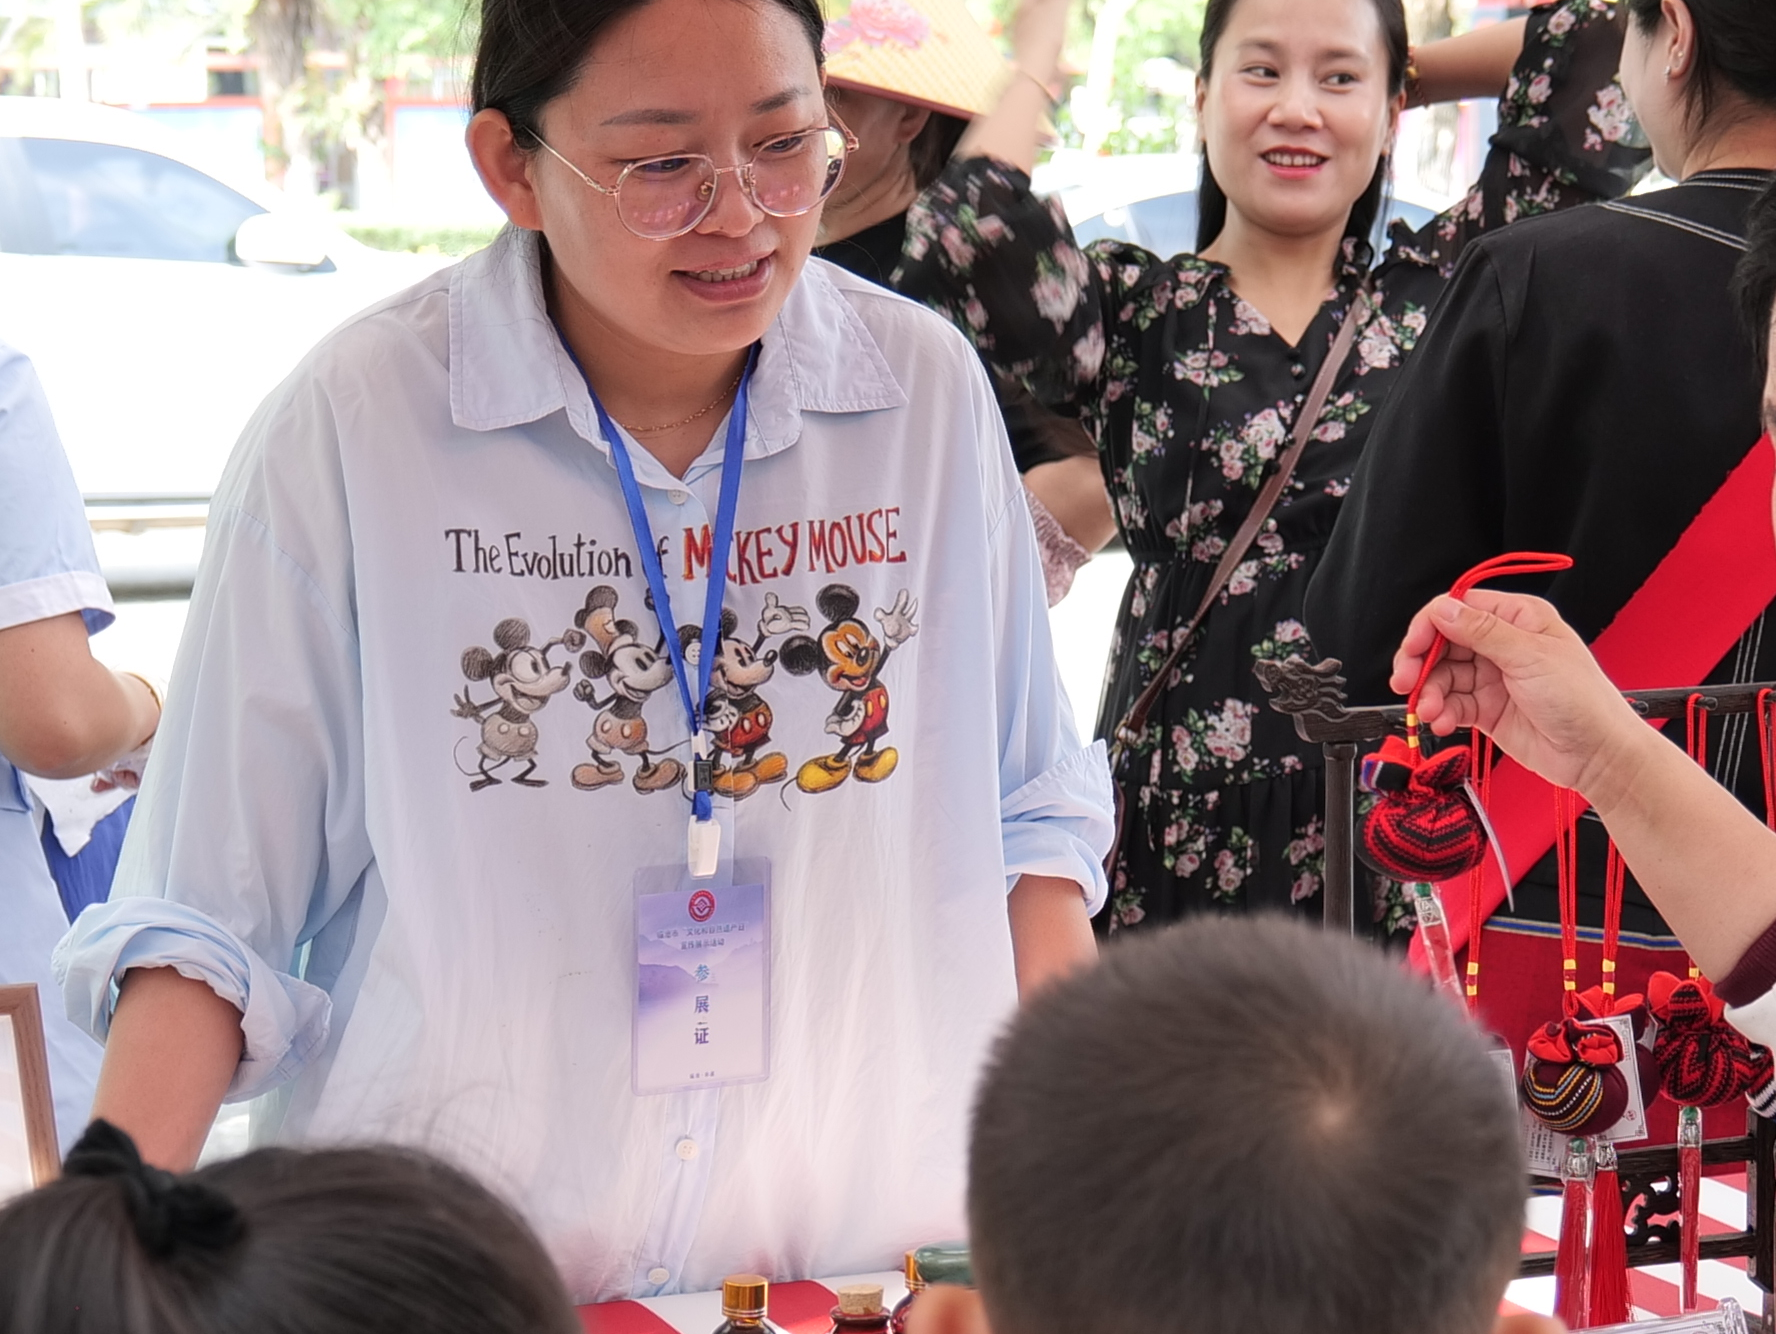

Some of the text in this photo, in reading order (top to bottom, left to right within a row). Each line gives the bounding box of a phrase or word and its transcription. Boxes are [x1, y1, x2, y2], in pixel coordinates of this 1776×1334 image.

[445, 507, 907, 585] The Evolution f MKEY MOUSE
[693, 964, 710, 1045] 参展证
